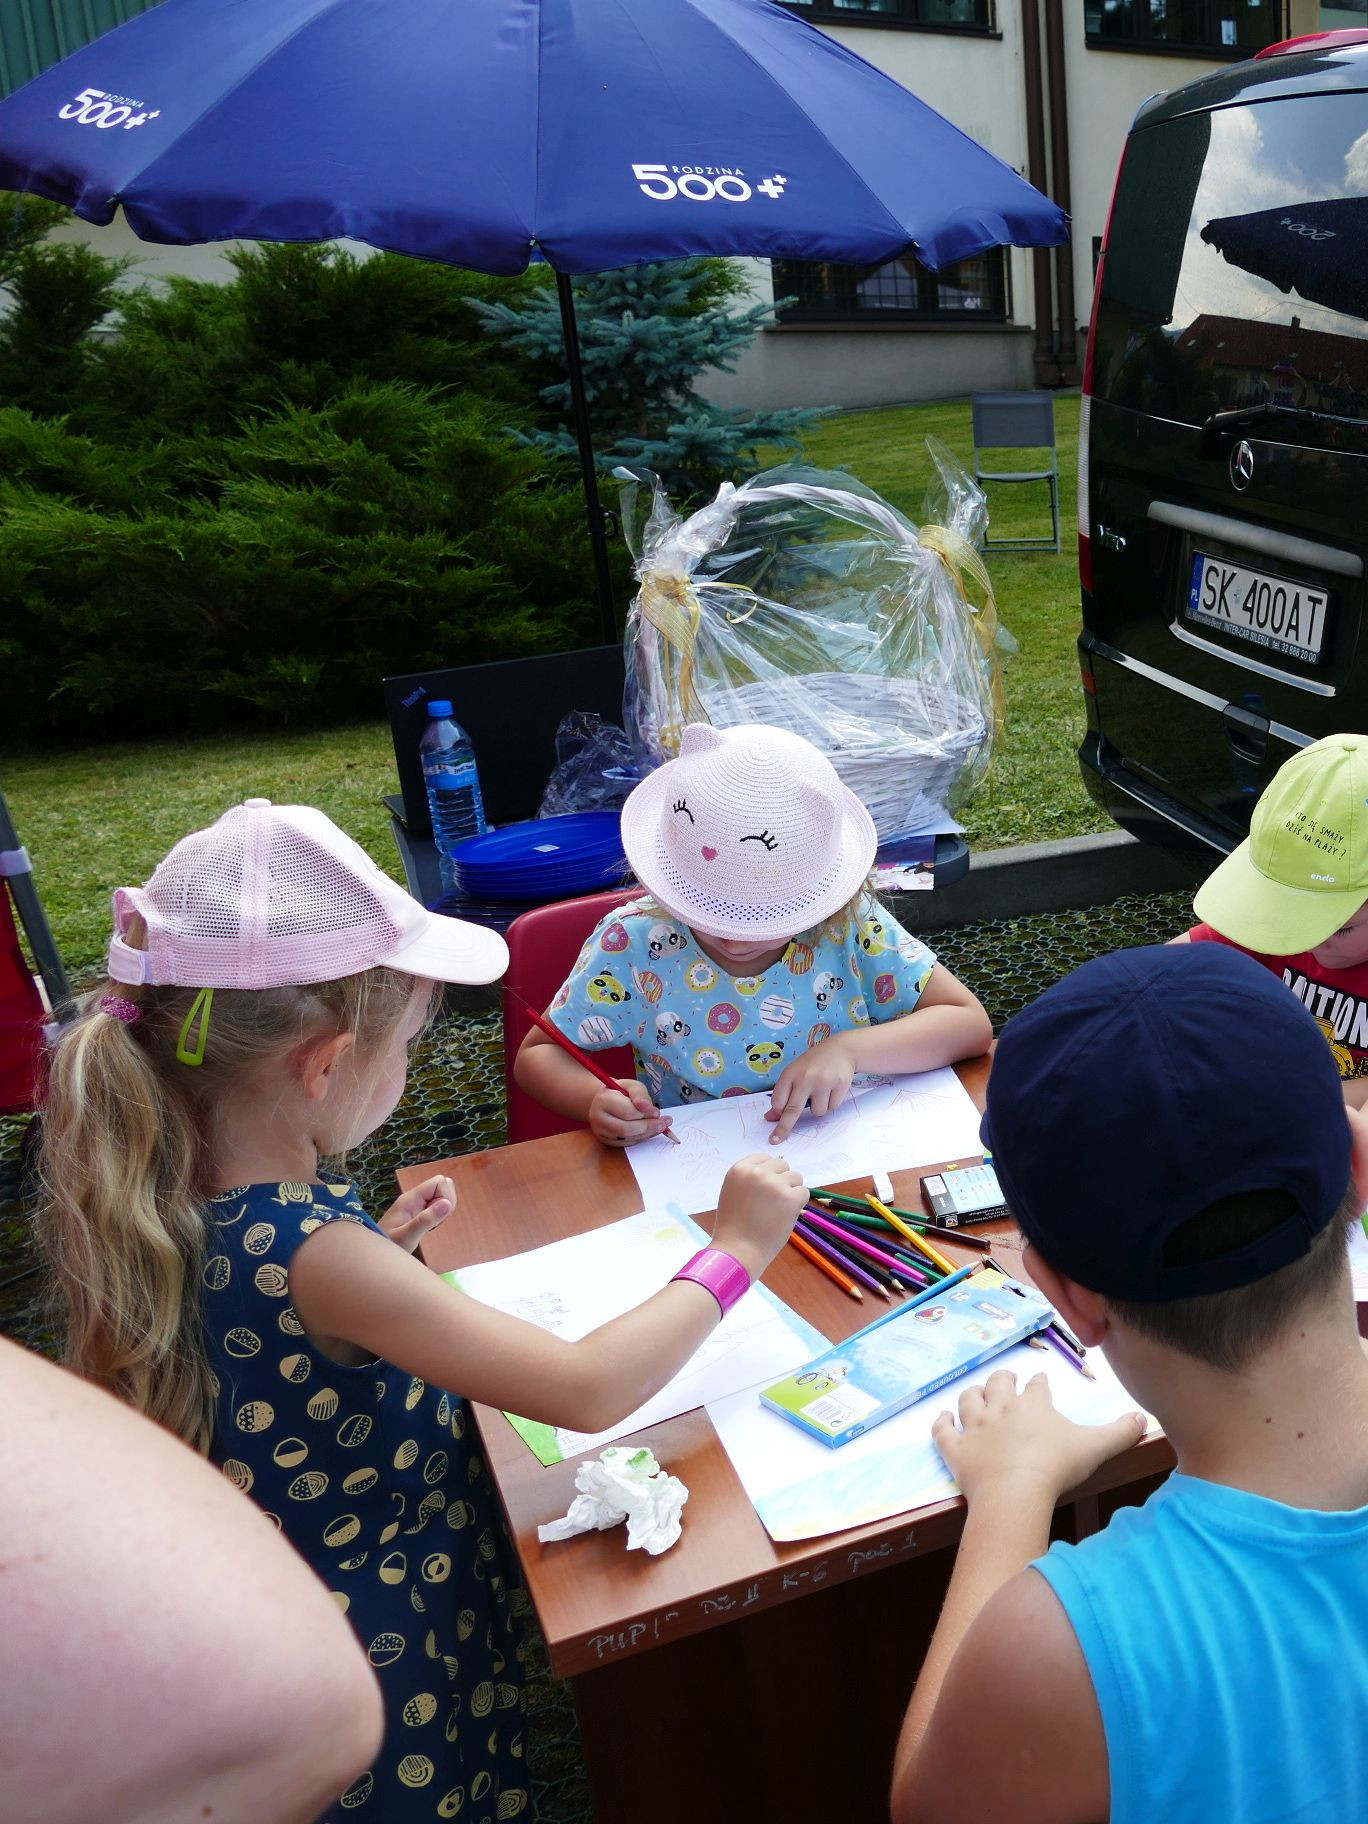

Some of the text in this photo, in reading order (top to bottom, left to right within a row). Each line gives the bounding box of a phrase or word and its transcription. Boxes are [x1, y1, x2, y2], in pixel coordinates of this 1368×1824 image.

[671, 165, 745, 176] RODZINA
[1190, 588, 1199, 602] PL
[1203, 564, 1323, 646] SK 400AT
[1224, 623, 1250, 640] INTER-CAR
[1250, 631, 1269, 647] SILESIA
[1302, 834, 1313, 844] NA
[1310, 873, 1336, 883] endo
